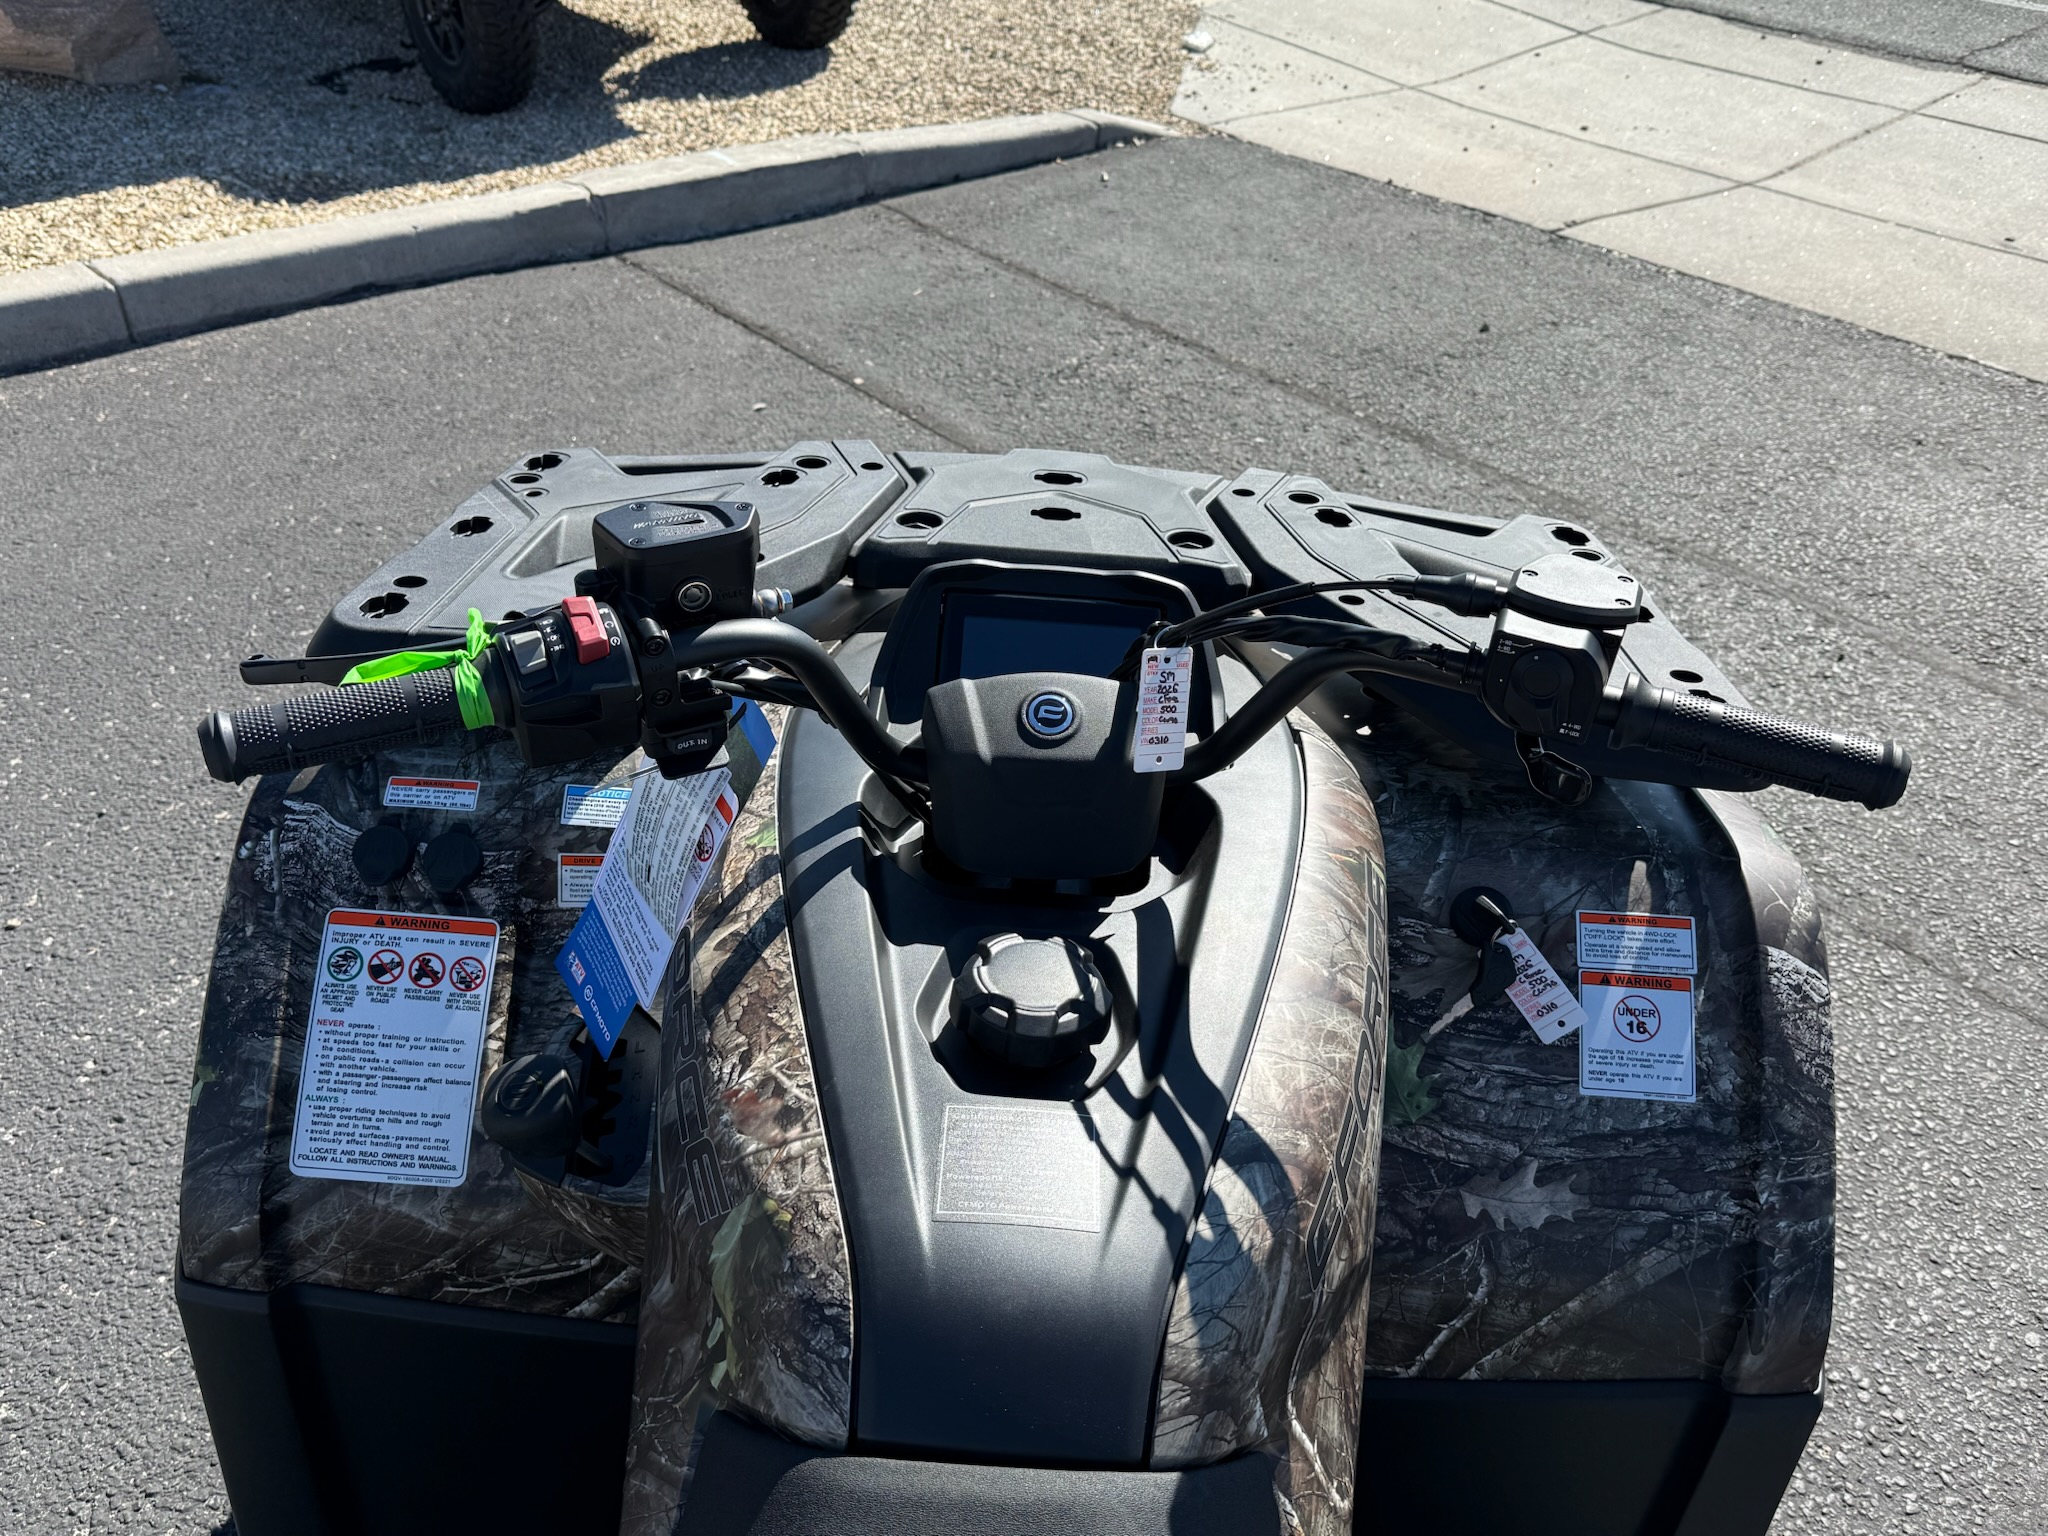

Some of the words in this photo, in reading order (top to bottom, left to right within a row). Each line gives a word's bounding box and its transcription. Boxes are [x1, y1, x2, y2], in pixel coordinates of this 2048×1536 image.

[1157, 683, 1179, 694] 2026
[390, 917, 450, 929] WARNING
[1617, 916, 1657, 925] WARNING
[332, 930, 365, 939] Improper
[1614, 976, 1671, 988] WARNING
[1618, 1007, 1656, 1018] UNDER
[316, 1018, 344, 1026] NEVER
[589, 998, 611, 1042] CFMOTO
[1626, 1020, 1647, 1034] 16
[381, 1033, 410, 1041] training
[424, 1036, 467, 1045] instruction.
[304, 1094, 339, 1103] ALWAYS
[328, 1106, 352, 1114] proper
[354, 1107, 375, 1115] riding
[378, 1109, 417, 1118] techniques
[309, 1147, 337, 1155] LOCATE
[346, 1157, 398, 1166] INSTRUCTIONS
[418, 1161, 458, 1171] WARNINGS.
